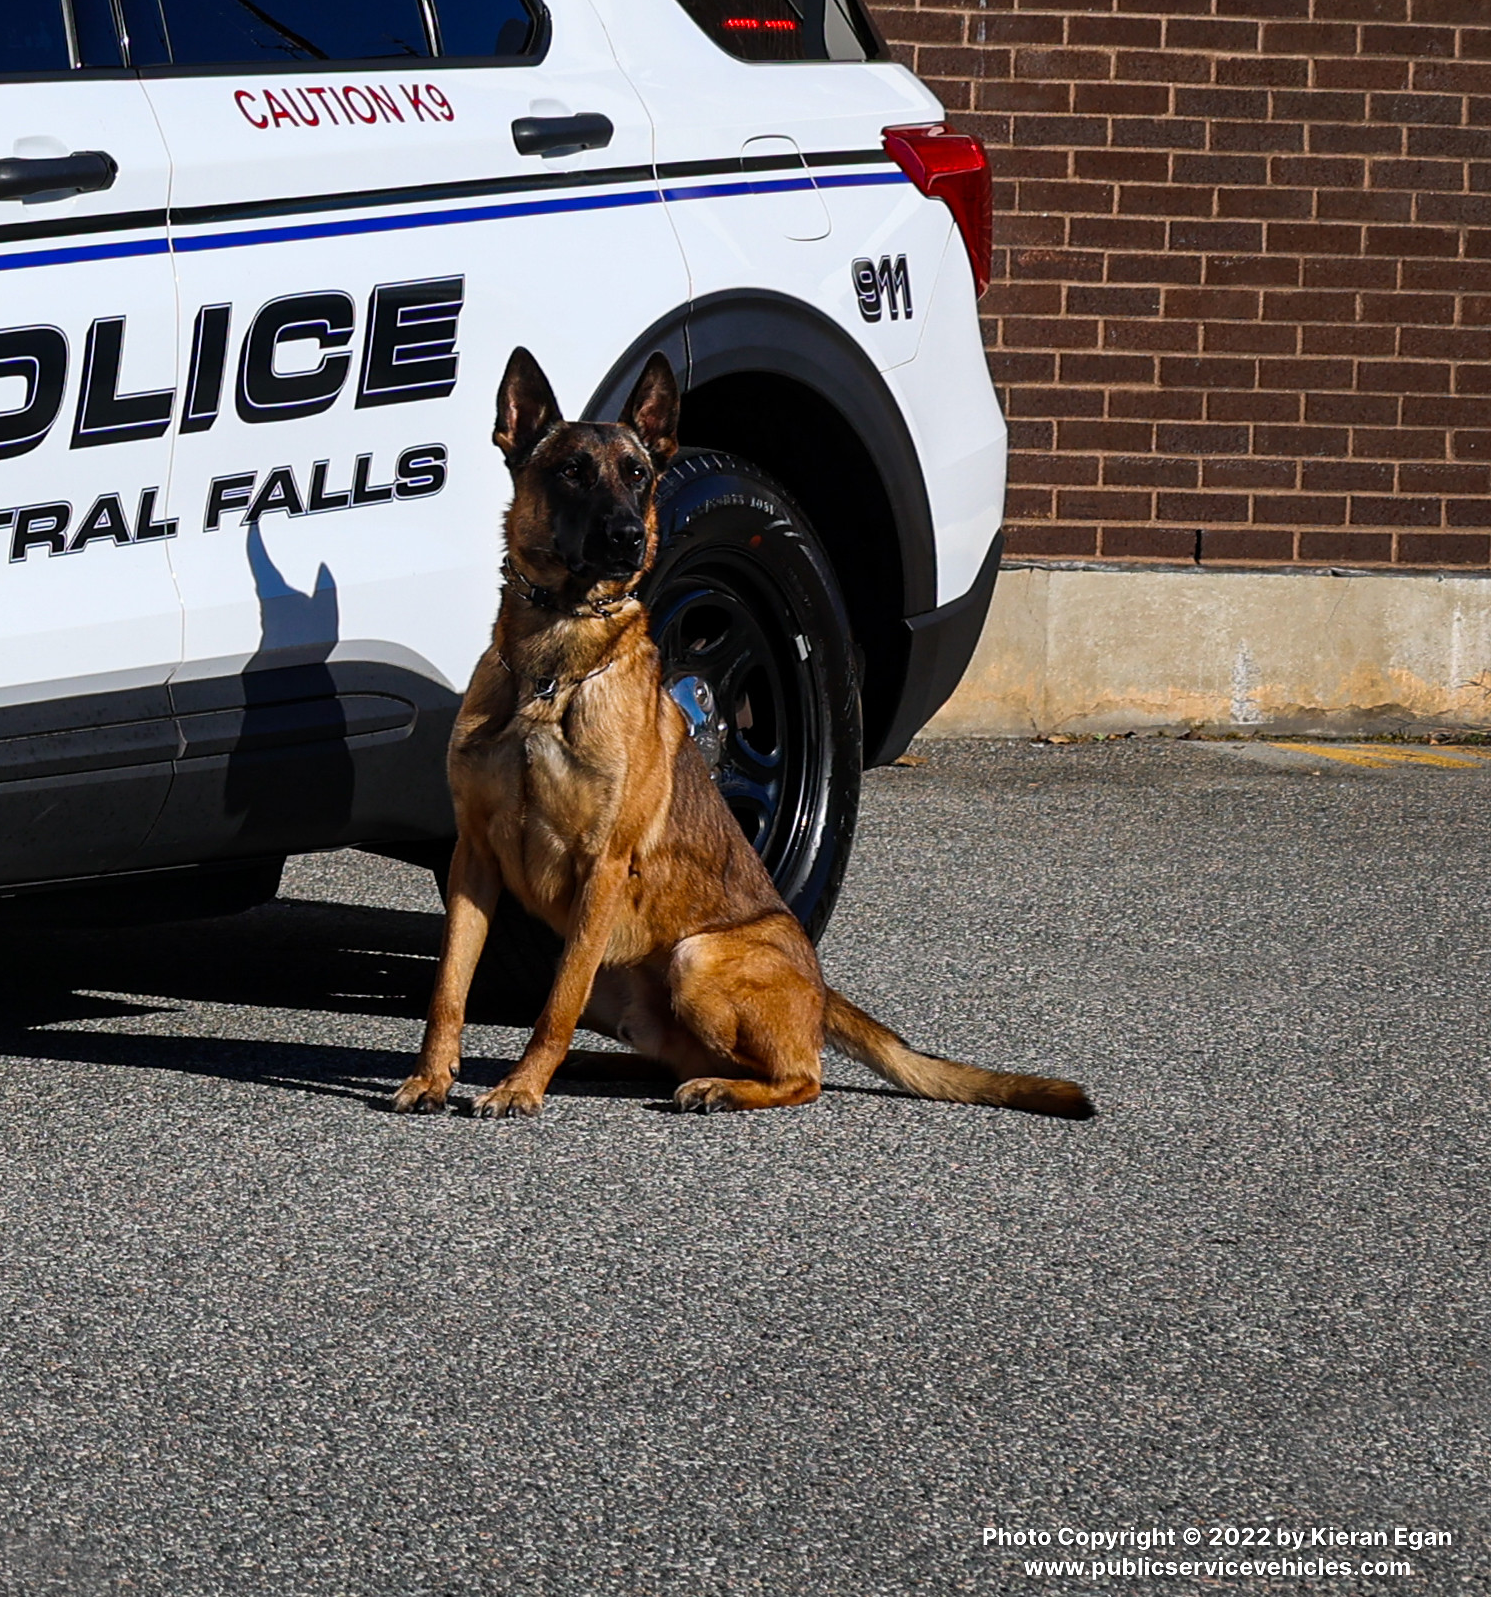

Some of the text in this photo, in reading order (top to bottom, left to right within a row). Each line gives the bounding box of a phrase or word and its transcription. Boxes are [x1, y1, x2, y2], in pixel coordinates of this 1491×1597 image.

[233, 83, 455, 130] CAUTION K9
[850, 253, 913, 324] 911
[203, 442, 448, 533] FALLS
